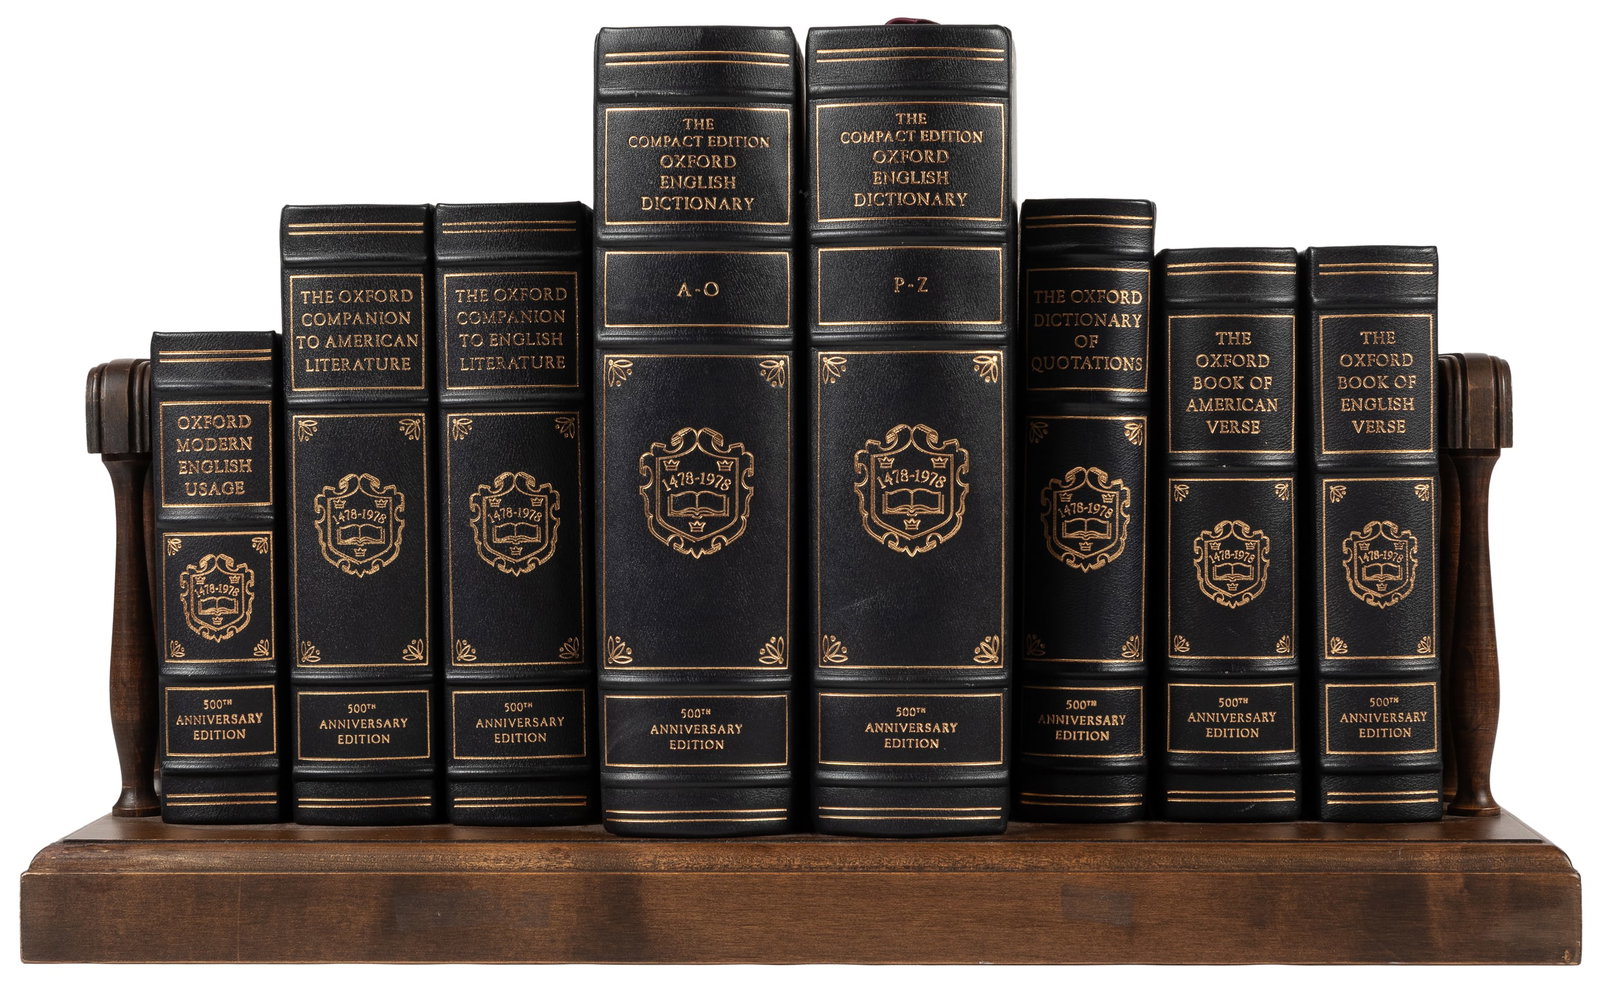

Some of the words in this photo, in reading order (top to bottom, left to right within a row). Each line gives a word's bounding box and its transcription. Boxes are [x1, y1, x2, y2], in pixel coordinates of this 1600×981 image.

[683, 118, 714, 130] THE
[895, 112, 927, 124] THE
[628, 136, 704, 147] COMPACT
[707, 136, 770, 147] EDITION
[840, 130, 916, 144] COMPACT
[920, 130, 983, 143] EDITION
[660, 155, 736, 168] OXFORD
[872, 149, 949, 163] OXFORD
[660, 175, 736, 189] ENGLISH
[872, 171, 949, 184] ENGLISH
[641, 196, 755, 210] DICTIONARY
[854, 192, 968, 207] DICTIONARY
[301, 290, 334, 304] THE
[339, 289, 414, 303] OXFORD
[456, 289, 489, 302] THE
[494, 288, 568, 300] OXFORD
[1034, 291, 1067, 305] THE
[1070, 289, 1143, 304] OXFORD
[301, 312, 411, 326] COMPANION
[457, 311, 566, 325] COMPANION
[1034, 314, 1141, 328] DICTIONARY
[296, 336, 320, 349] TO
[325, 334, 419, 347] AMERICAN
[459, 334, 483, 346] TO
[490, 334, 563, 346] ENGLISH
[1074, 335, 1099, 348] OF
[1216, 332, 1252, 345] THE
[1360, 331, 1396, 344] THE
[305, 357, 411, 371] LITERATURE
[460, 356, 566, 370] LITERATURE
[1030, 356, 1143, 371] QUOTATIONS
[1195, 353, 1270, 368] OXFORD
[1339, 353, 1413, 367] OXFORD
[1193, 376, 1245, 390] BOOK
[1248, 376, 1273, 389] OF
[1337, 376, 1390, 389] BOOK
[1394, 375, 1418, 389] OF
[1186, 398, 1279, 412] AMERICAN
[1341, 397, 1415, 411] ENGLISH
[178, 415, 252, 429] OXFORD
[1206, 420, 1261, 434] VERSE
[1351, 419, 1406, 433] VERSE
[176, 436, 253, 452] MODERN
[178, 459, 252, 474] ENGLISH
[662, 472, 731, 492] 1478-1978
[876, 469, 947, 490] 1478-1978
[184, 481, 245, 496] USAGE
[332, 509, 386, 526] 1478-1978
[488, 508, 542, 525] 1478-1978
[1057, 501, 1114, 520] 1478-1978
[1210, 549, 1256, 565] 1478-1978
[1357, 548, 1404, 564] 1478-1978
[194, 581, 240, 598] 1478-1978
[176, 712, 263, 725] ANNIVERSARY
[319, 718, 408, 728] ANNIVERSARY
[476, 717, 565, 728] ANNIVERSARY
[1038, 715, 1127, 726] ANNIVERSARY
[1187, 712, 1277, 722] ANNIVERSARY
[1340, 712, 1428, 722] ANNIVERSARY
[193, 729, 246, 740] EDITION
[650, 724, 743, 734] ANNIVERSARY
[865, 723, 958, 733] ANNIVERSARY
[1205, 728, 1259, 738] EDITION
[1359, 728, 1412, 738] EDITION
[337, 734, 391, 744] EDITION
[494, 733, 547, 743] EDITION
[1055, 730, 1110, 741] EDITION
[669, 740, 724, 750] EDITION
[884, 738, 939, 748] EDITION
